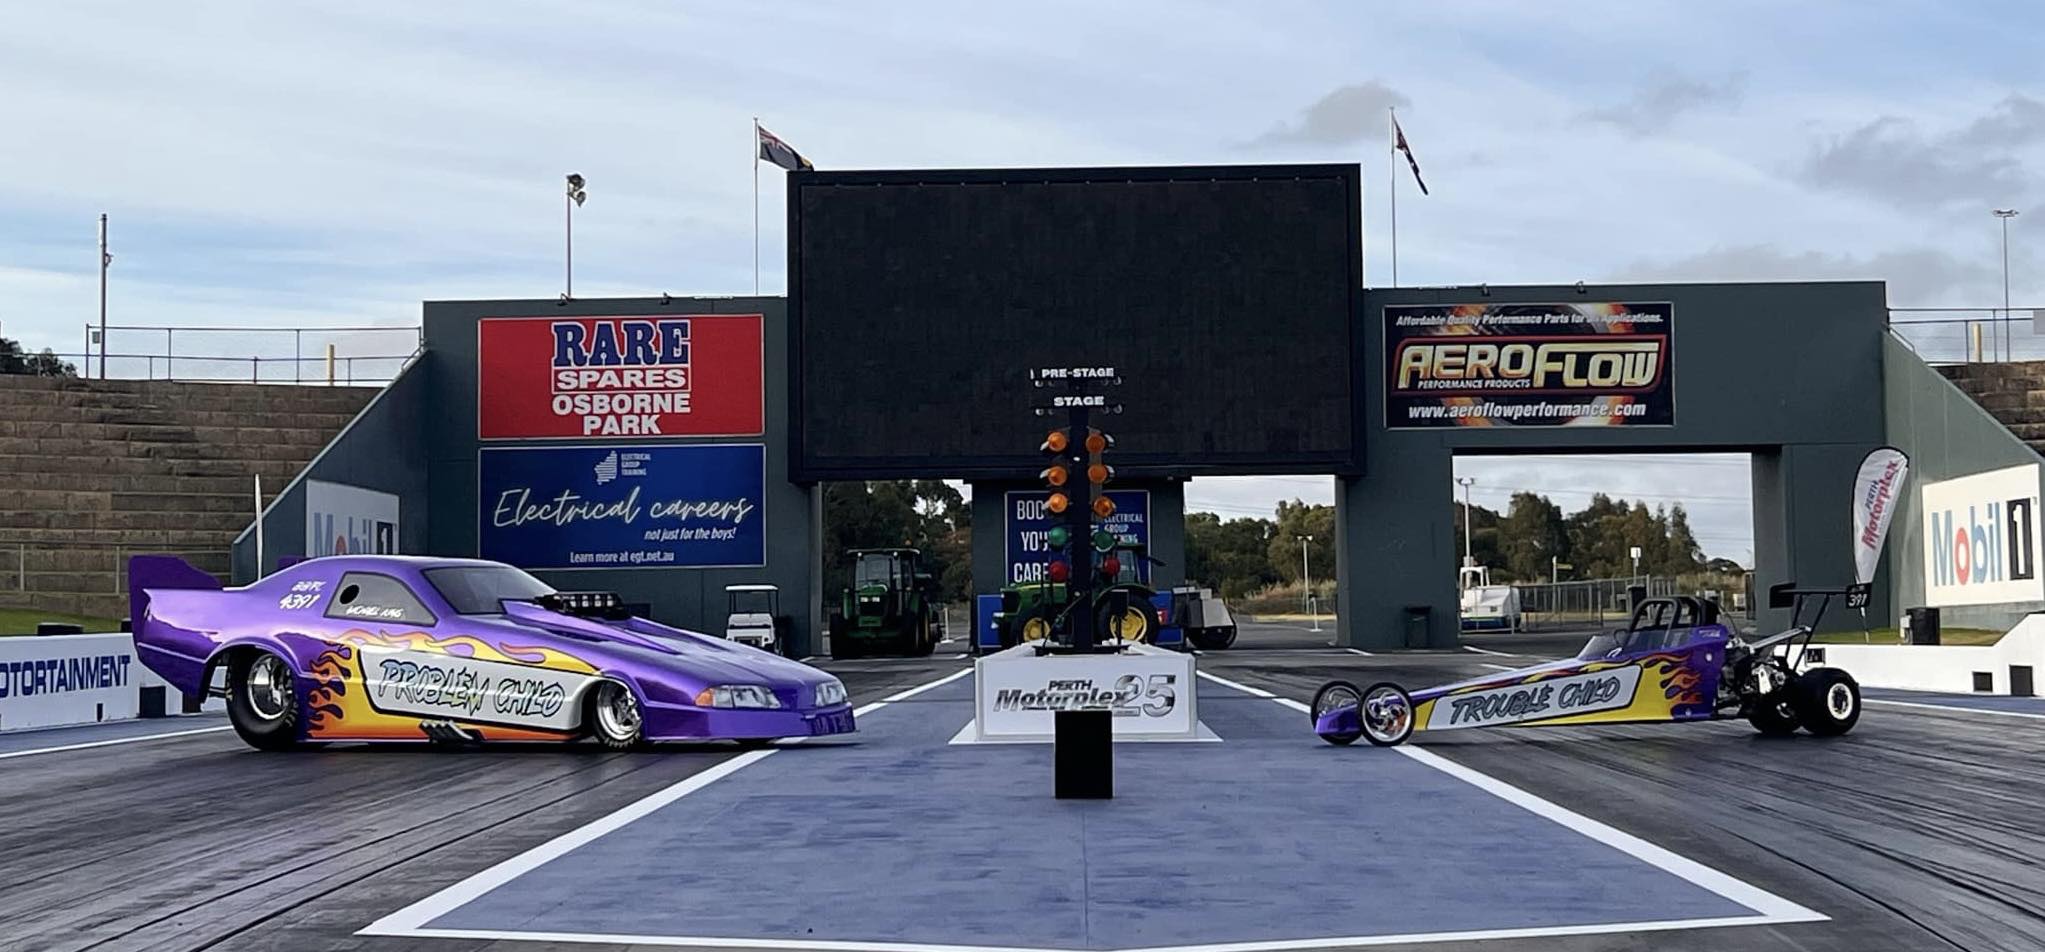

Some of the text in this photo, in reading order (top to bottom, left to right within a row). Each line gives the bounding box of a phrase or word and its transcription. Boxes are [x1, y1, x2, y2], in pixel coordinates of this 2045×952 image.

[1396, 315, 1446, 326] Affordable
[1447, 314, 1480, 326] Quality
[1482, 313, 1543, 325] Performance
[1544, 313, 1569, 324] Parts
[1571, 313, 1585, 323] for
[552, 320, 691, 368] RARE
[556, 369, 686, 390] SPARES
[1041, 367, 1114, 378] PRE-STAGE
[1417, 379, 1531, 389] PERFORMANCE PRODUCTS
[552, 394, 691, 415] OSBORNE
[1053, 396, 1105, 407] STAGE
[1408, 402, 1646, 421] www.aeroflowperformance.com
[583, 415, 661, 435] PARK
[1862, 460, 1898, 550] Motorplex
[1864, 480, 1879, 511] PERTH
[493, 486, 754, 527] Electrical careers
[644, 526, 737, 542] not just for the boys!
[1931, 500, 2030, 587] Mobil 1
[570, 551, 674, 564] Learn more at egt.net.au
[279, 594, 321, 609] 4391
[1848, 593, 1868, 607] 391
[379, 658, 566, 718] PROBLEM CHILD
[1049, 679, 1093, 691] PERTH
[993, 674, 1177, 718] Motorplex 25
[1450, 675, 1622, 725] TROUBLE CHILD
